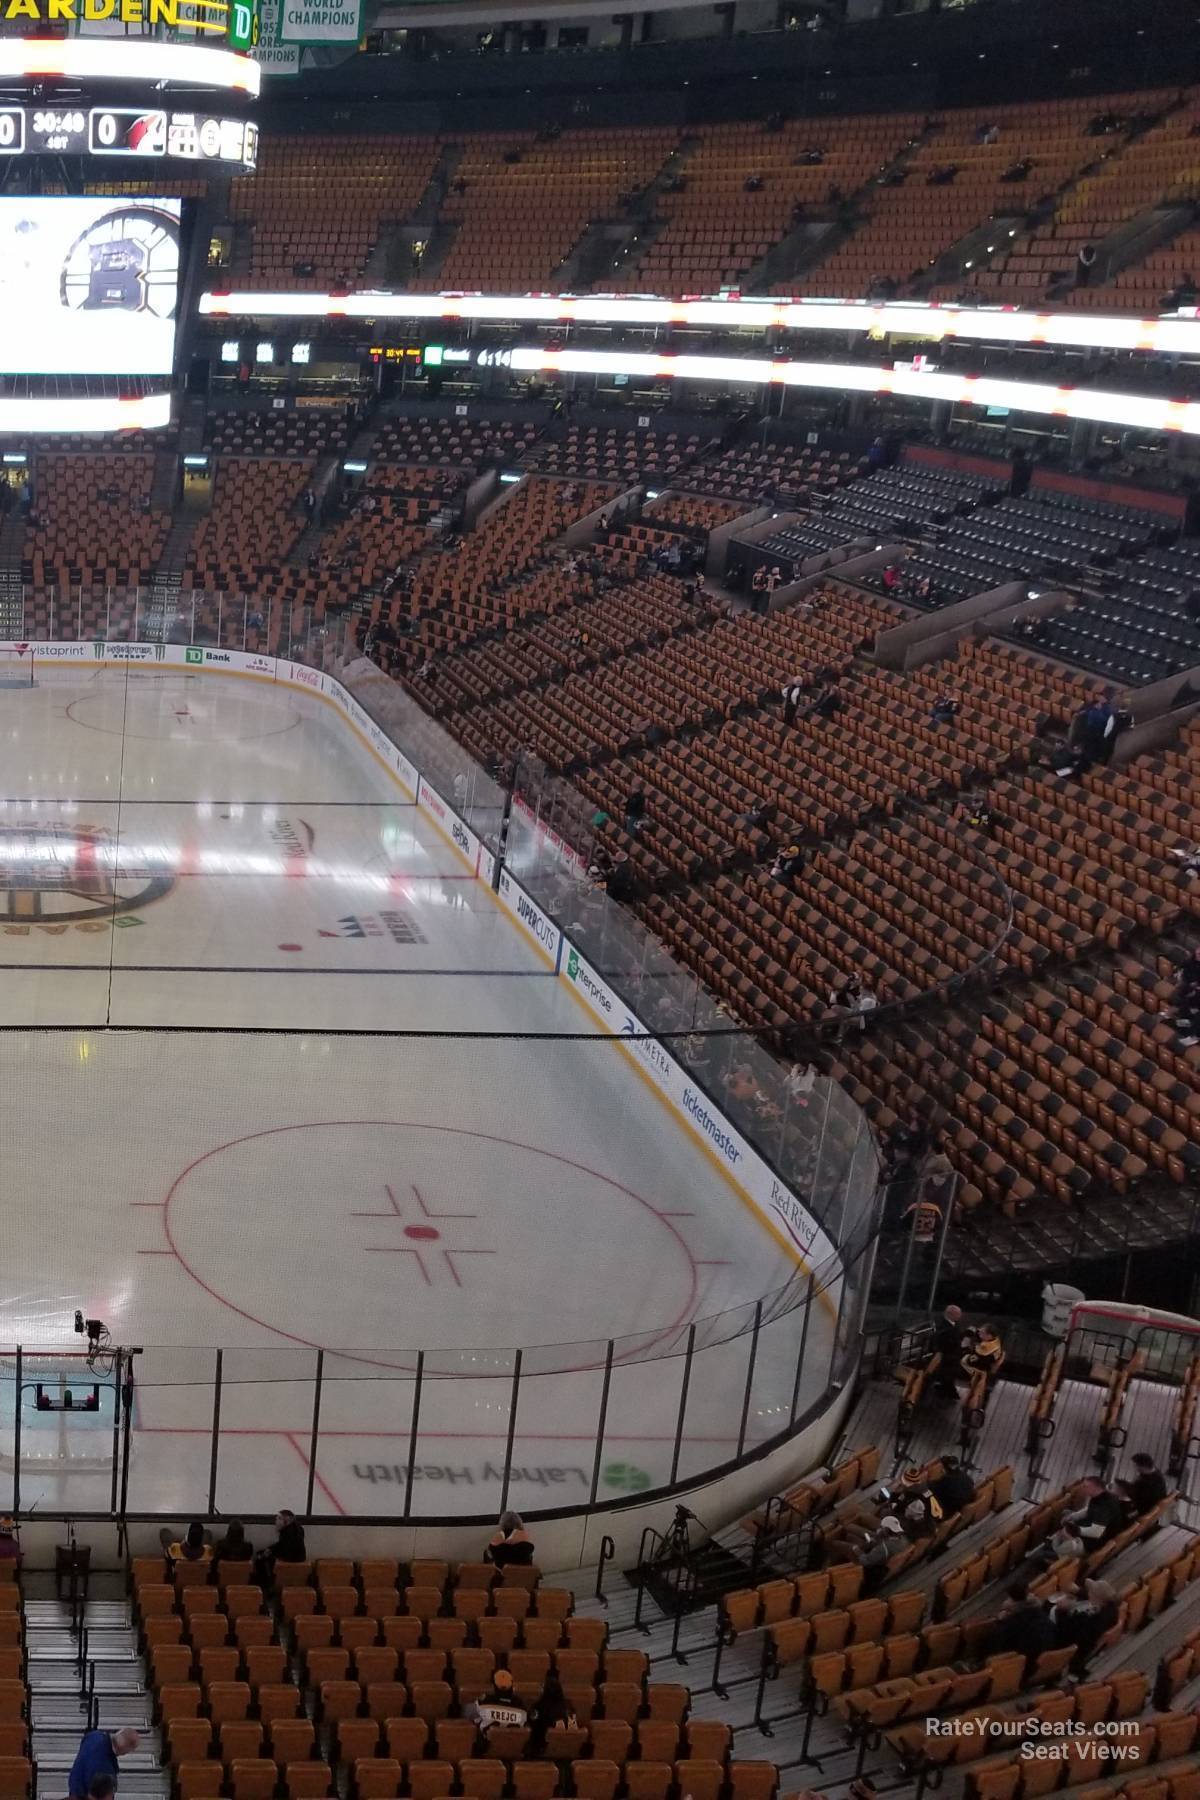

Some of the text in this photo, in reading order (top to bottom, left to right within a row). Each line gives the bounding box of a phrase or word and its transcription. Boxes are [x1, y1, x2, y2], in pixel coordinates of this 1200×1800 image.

[234, 4, 251, 40] TD
[288, 10, 356, 26] CHAMPIONS
[252, 50, 296, 62] AMPIONS
[98, 114, 117, 145] 0
[31, 645, 84, 656] vistaprint
[205, 651, 231, 663] Bank
[516, 895, 556, 951] SUPERCUTS
[568, 949, 613, 1014] enterprise
[682, 1088, 741, 1164] ticketmaster
[770, 1180, 815, 1242] Red River
[352, 1461, 590, 1488] Lahey Health
[490, 1709, 518, 1723] KREJCI
